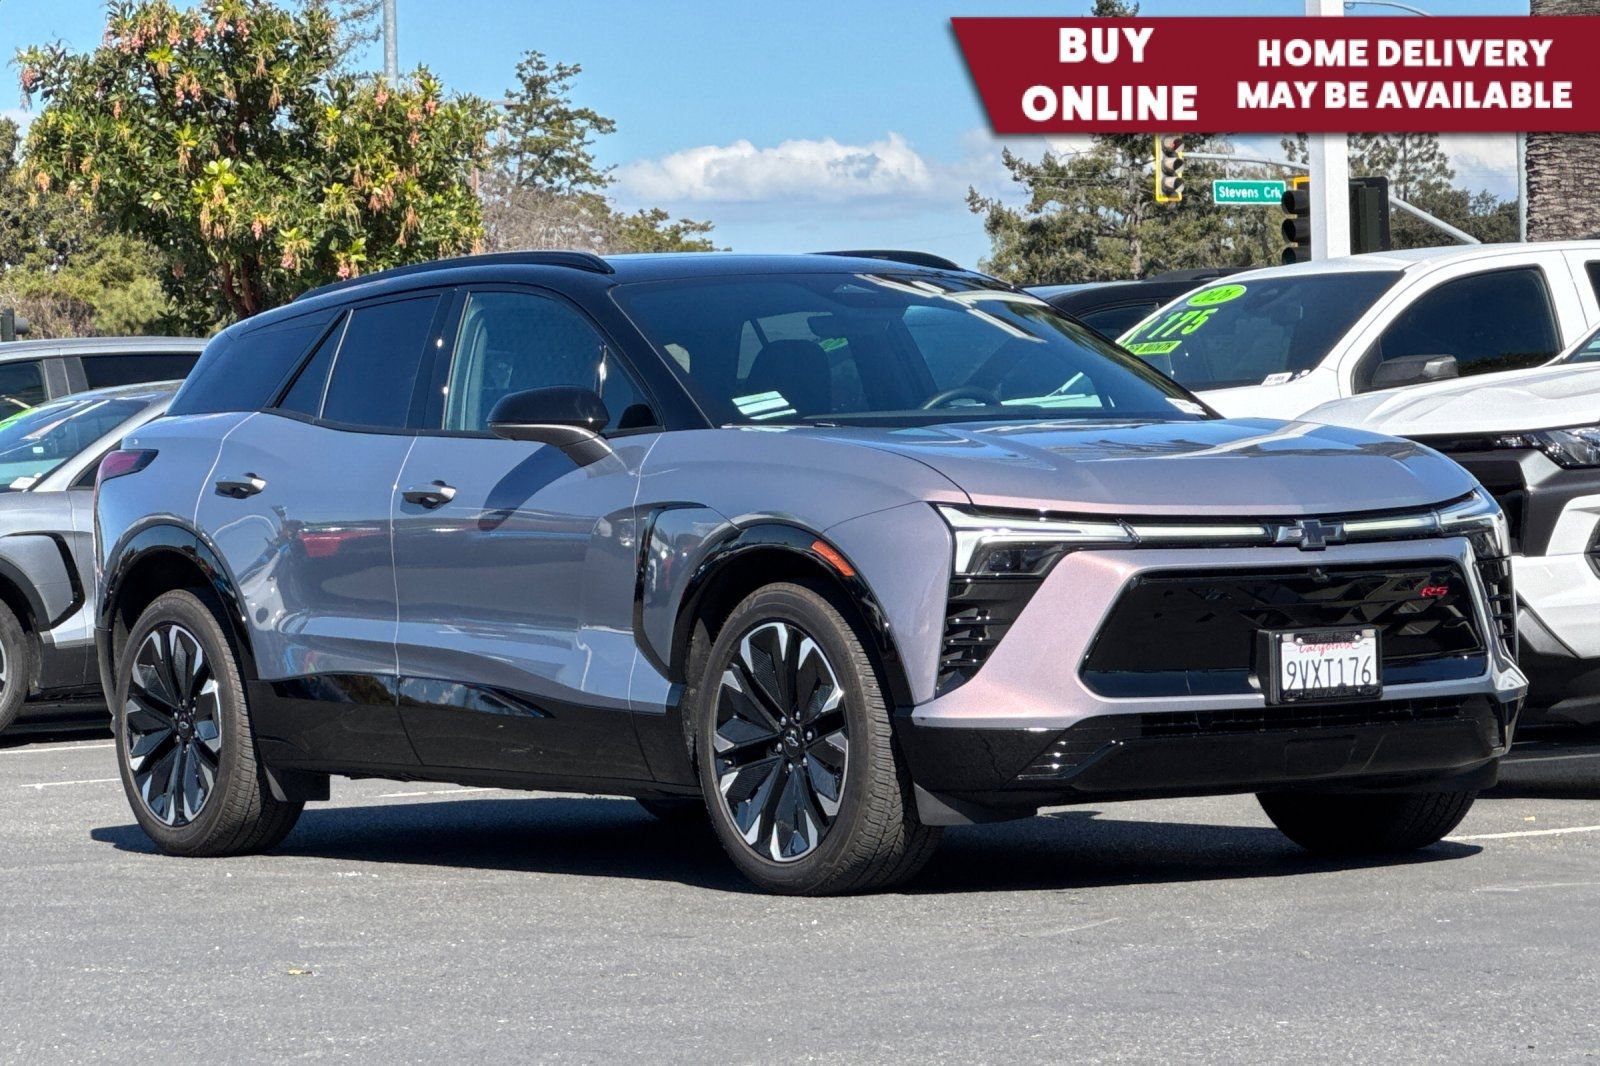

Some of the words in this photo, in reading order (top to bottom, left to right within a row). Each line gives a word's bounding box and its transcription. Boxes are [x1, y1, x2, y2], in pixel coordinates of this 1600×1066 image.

[1219, 186, 1259, 198] Stevens
[1264, 186, 1282, 199] Crk
[1421, 586, 1448, 597] RS
[1286, 656, 1371, 690] 9VXT176
